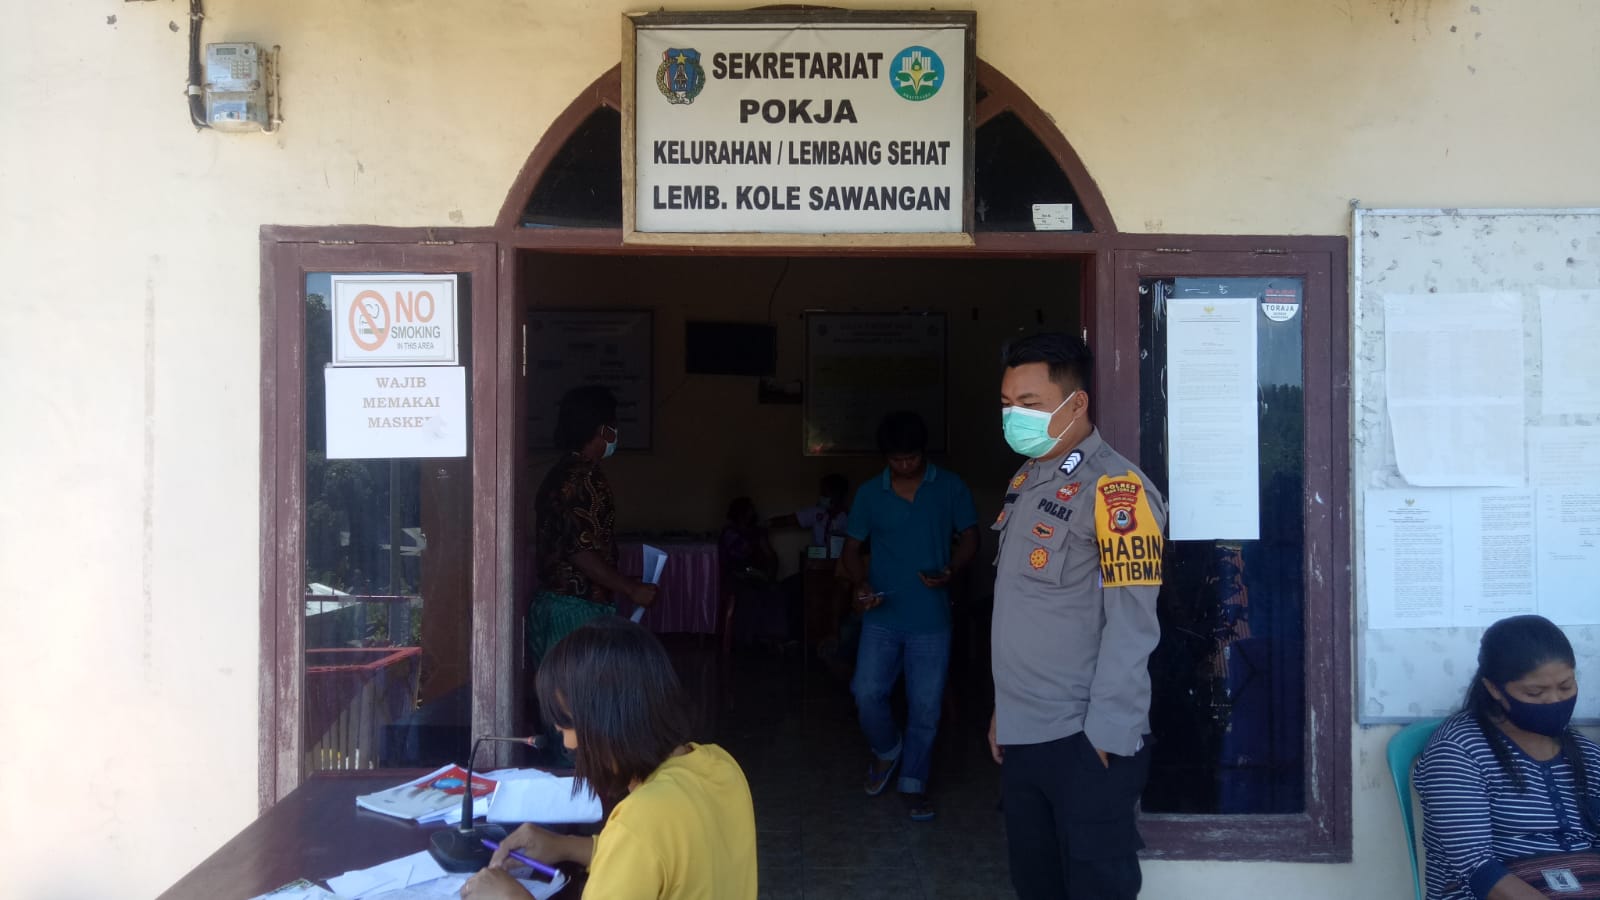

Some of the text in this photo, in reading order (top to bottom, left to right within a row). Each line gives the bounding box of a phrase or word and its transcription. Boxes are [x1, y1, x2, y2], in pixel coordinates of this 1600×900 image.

[712, 52, 883, 80] SEKRETARIAT
[739, 99, 858, 124] POKJA
[653, 140, 951, 165] KELURAHAN / LEMBANG SEHAT
[653, 185, 951, 211] LEMB. KOLE SAWANGAN
[395, 290, 435, 323] NO
[1265, 304, 1295, 312] TORAJA
[391, 326, 441, 339] SMOKING
[404, 342, 417, 350] THIS
[418, 342, 434, 350] AREA
[375, 376, 427, 389] WAJIB
[362, 396, 440, 409] MEMAKAI
[367, 416, 432, 429] MASKE
[1103, 483, 1136, 492] POLRES
[1037, 497, 1073, 522] POLRI
